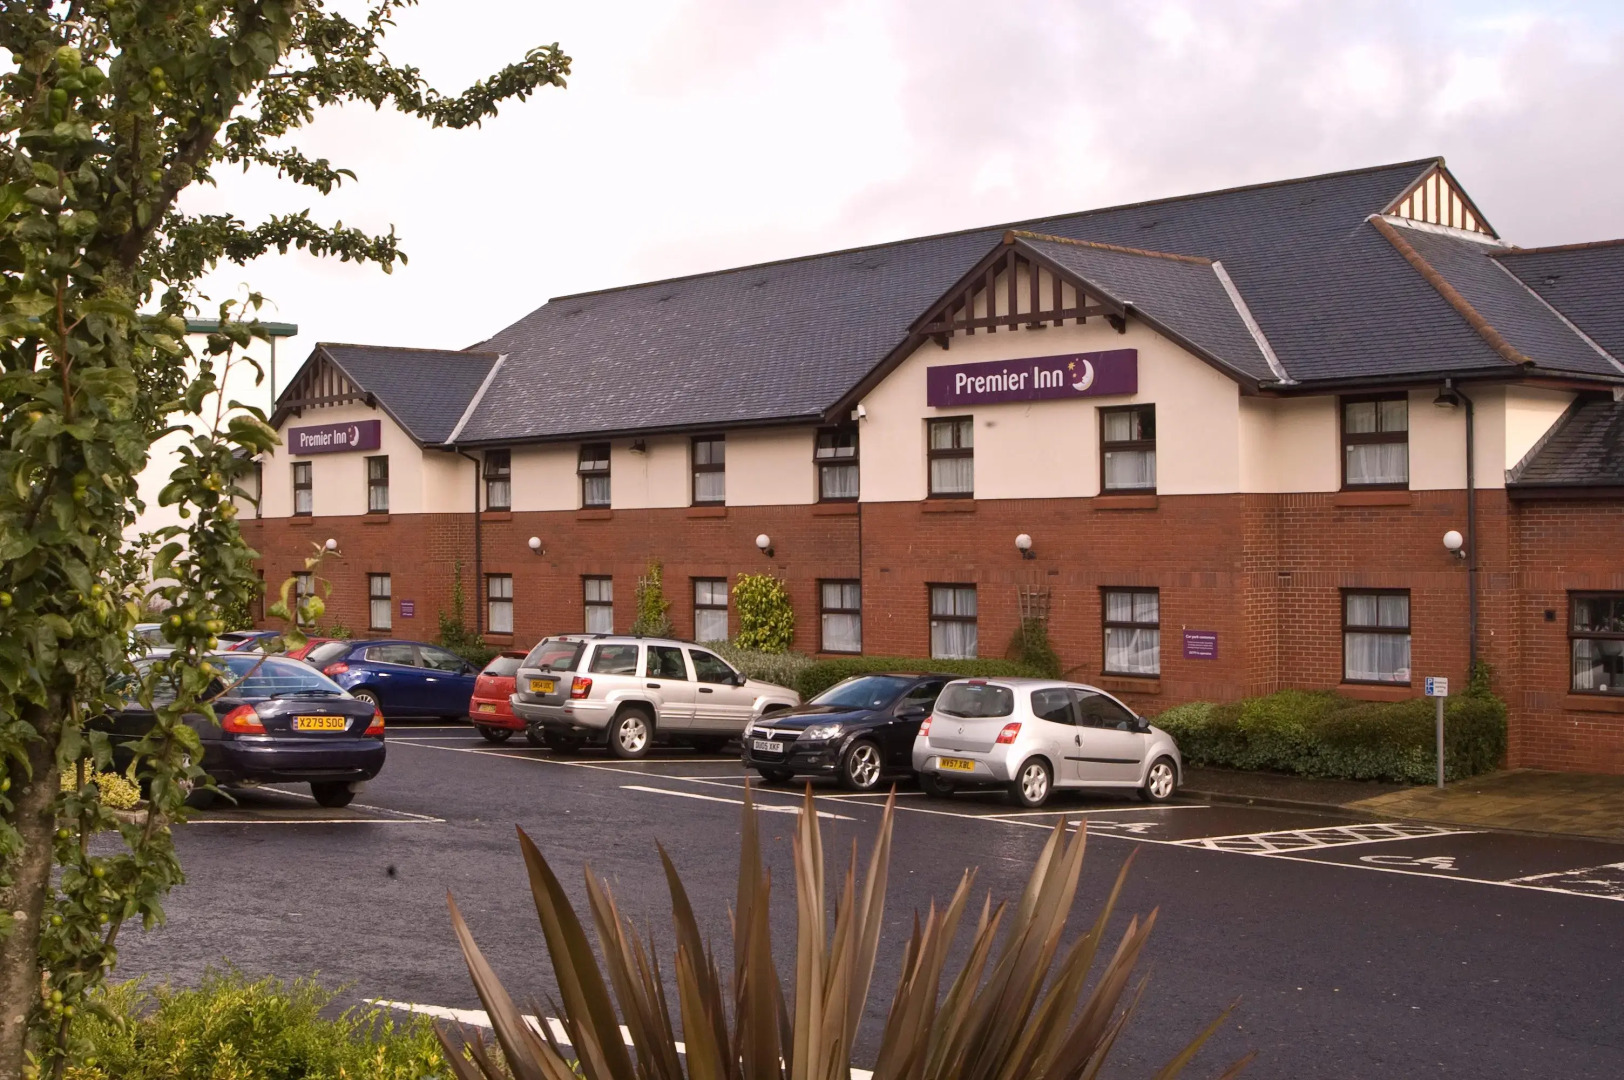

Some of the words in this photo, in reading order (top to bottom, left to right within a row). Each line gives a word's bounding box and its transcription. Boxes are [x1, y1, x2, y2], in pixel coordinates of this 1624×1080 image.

[955, 368, 1028, 395] Premier
[1033, 366, 1064, 389] Inn
[300, 430, 332, 448] Premier
[333, 429, 347, 445] Inn
[299, 717, 324, 728] X279
[325, 717, 344, 728] SOG
